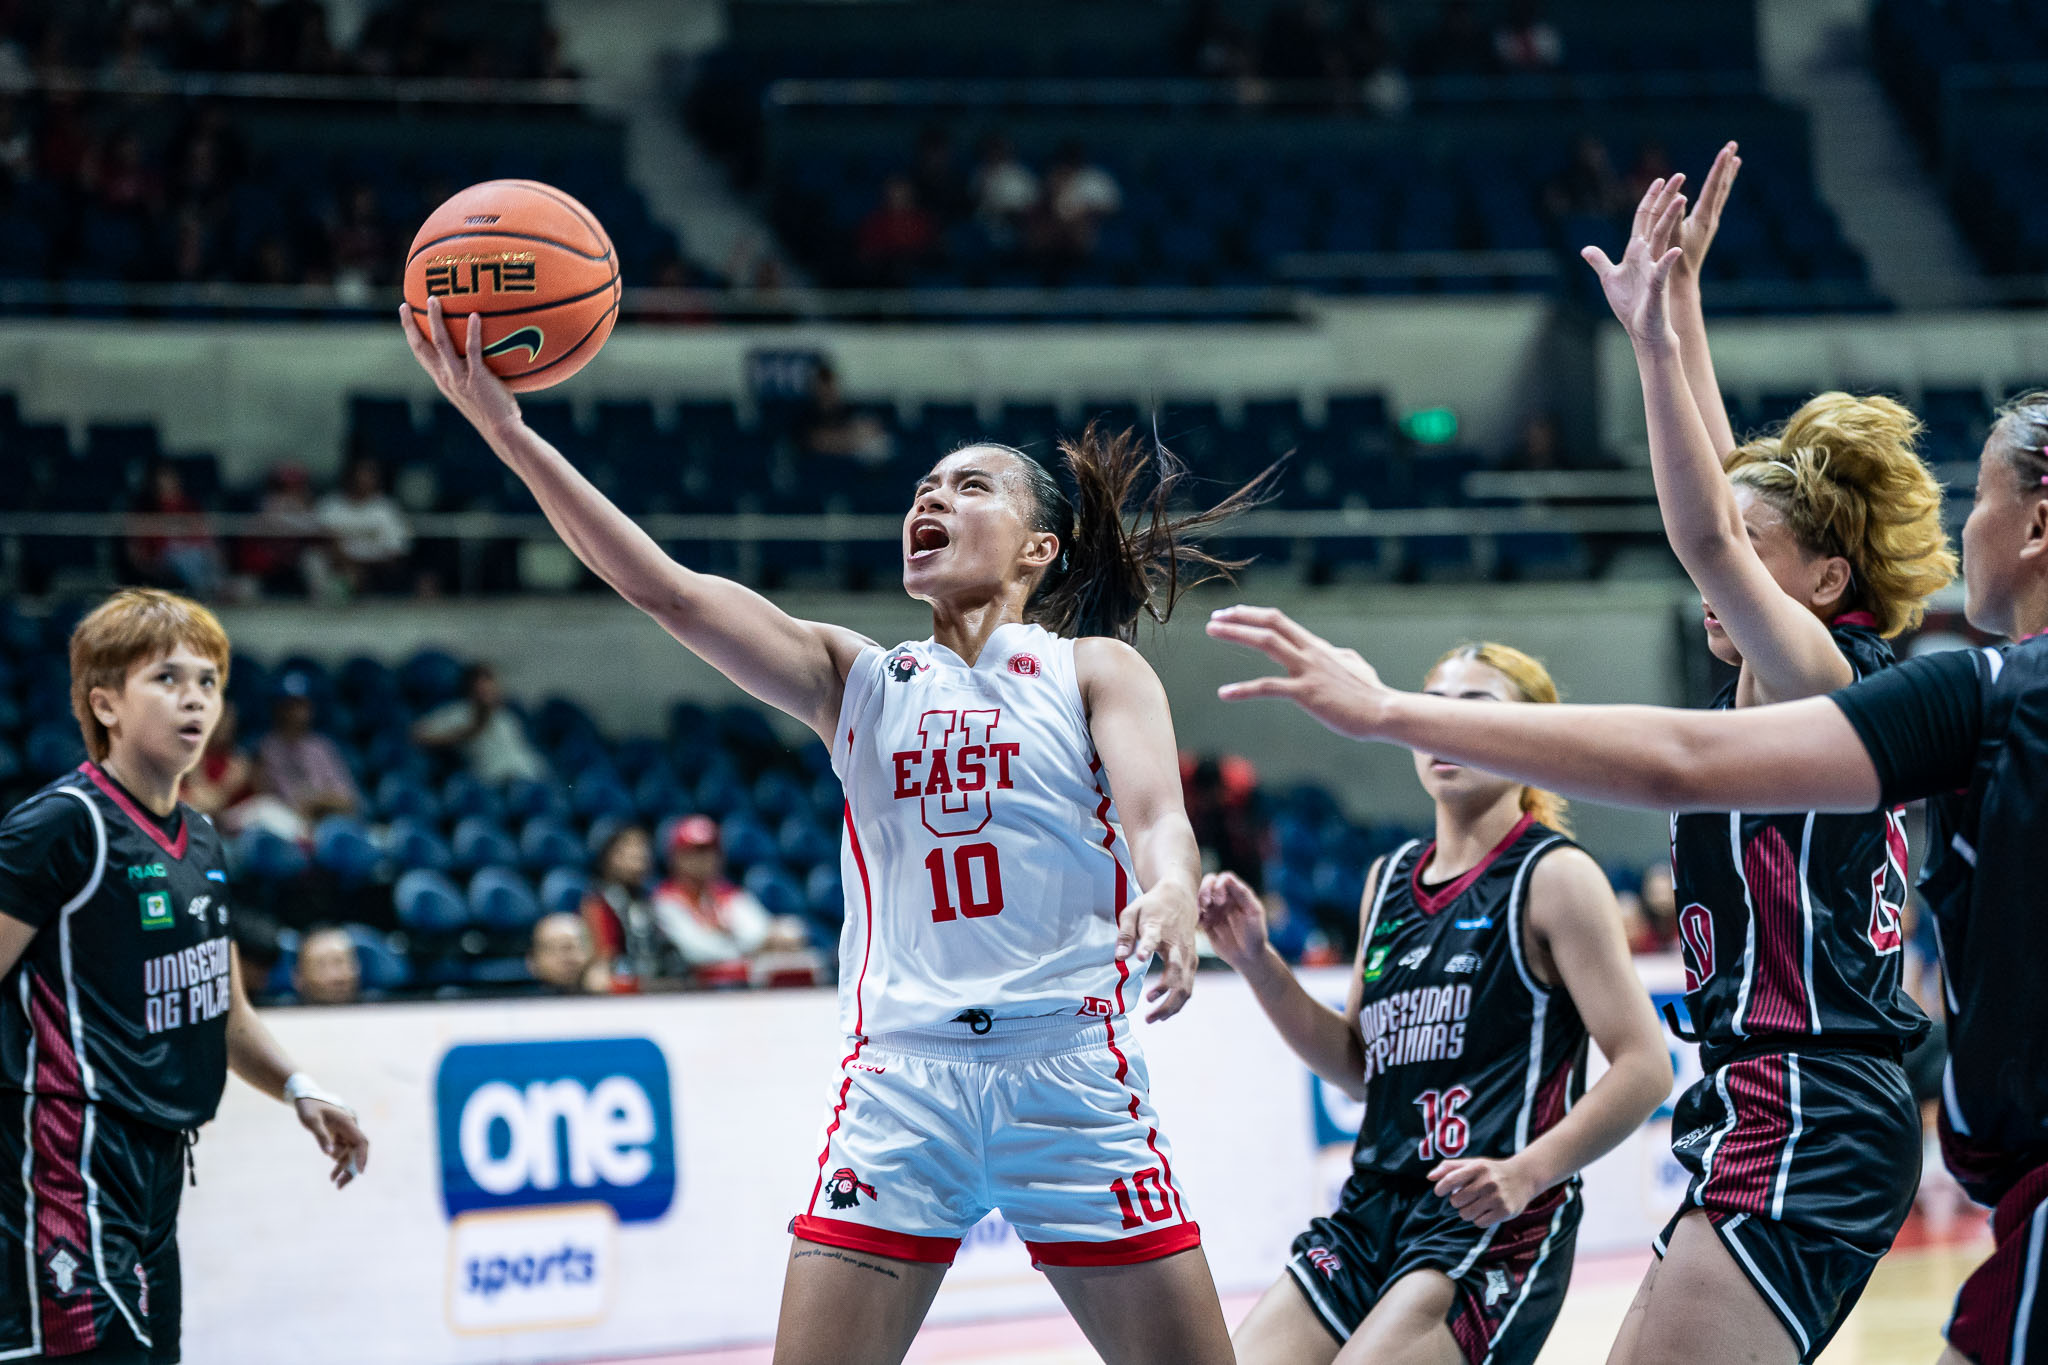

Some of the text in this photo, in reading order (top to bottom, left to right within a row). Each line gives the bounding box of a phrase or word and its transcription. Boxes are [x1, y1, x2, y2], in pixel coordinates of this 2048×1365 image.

[426, 262, 536, 297] ELITE
[892, 742, 1020, 800] EAST
[924, 842, 1004, 923] 10
[459, 1073, 656, 1195] one
[1413, 1084, 1471, 1160] 16
[1109, 1167, 1173, 1231] 10
